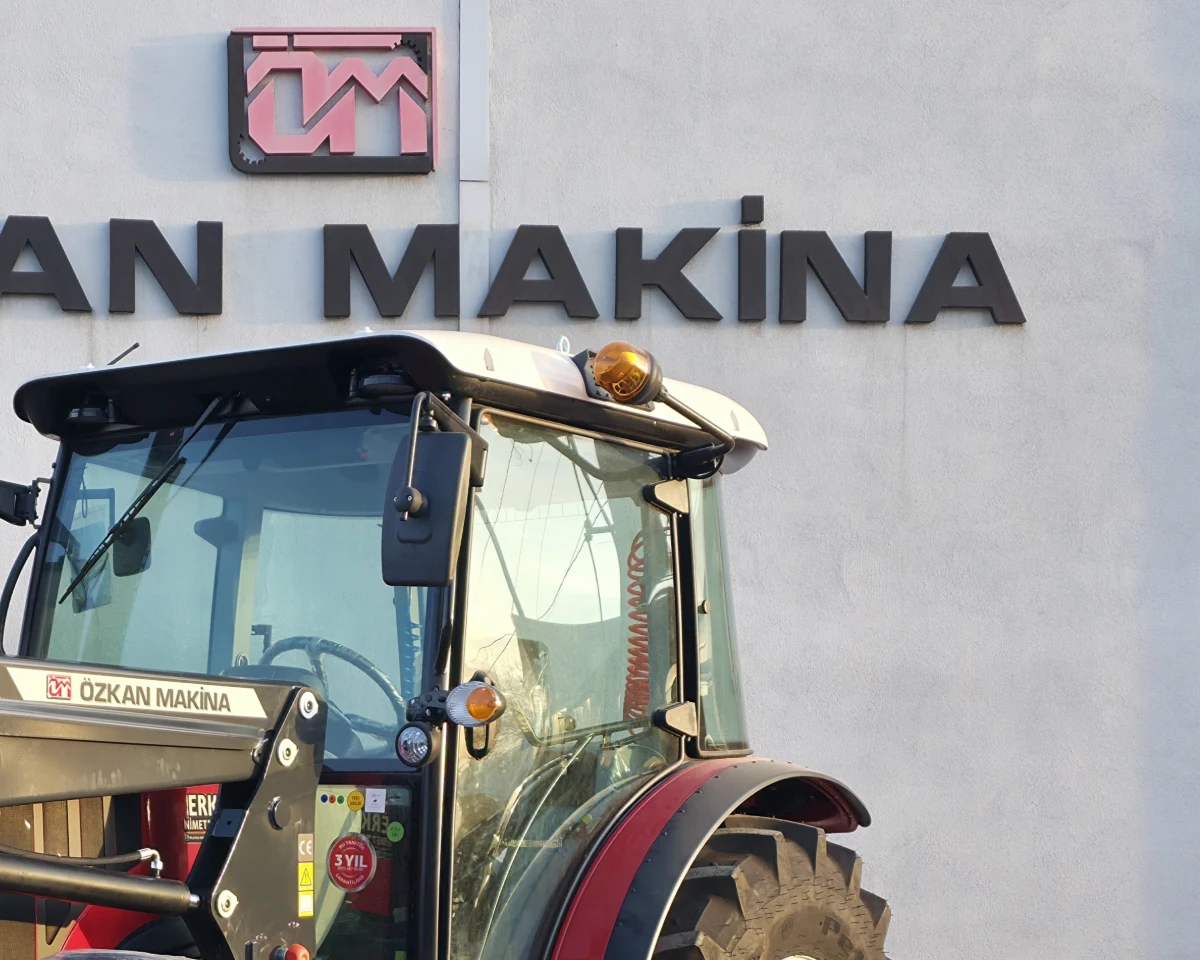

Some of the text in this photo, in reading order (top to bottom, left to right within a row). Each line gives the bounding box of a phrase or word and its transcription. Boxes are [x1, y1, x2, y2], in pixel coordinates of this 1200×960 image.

[323, 196, 1024, 326] MAKİNA
[79, 677, 231, 712] ÖZKAN MAKİNA
[334, 853, 368, 868] 3 YIL
